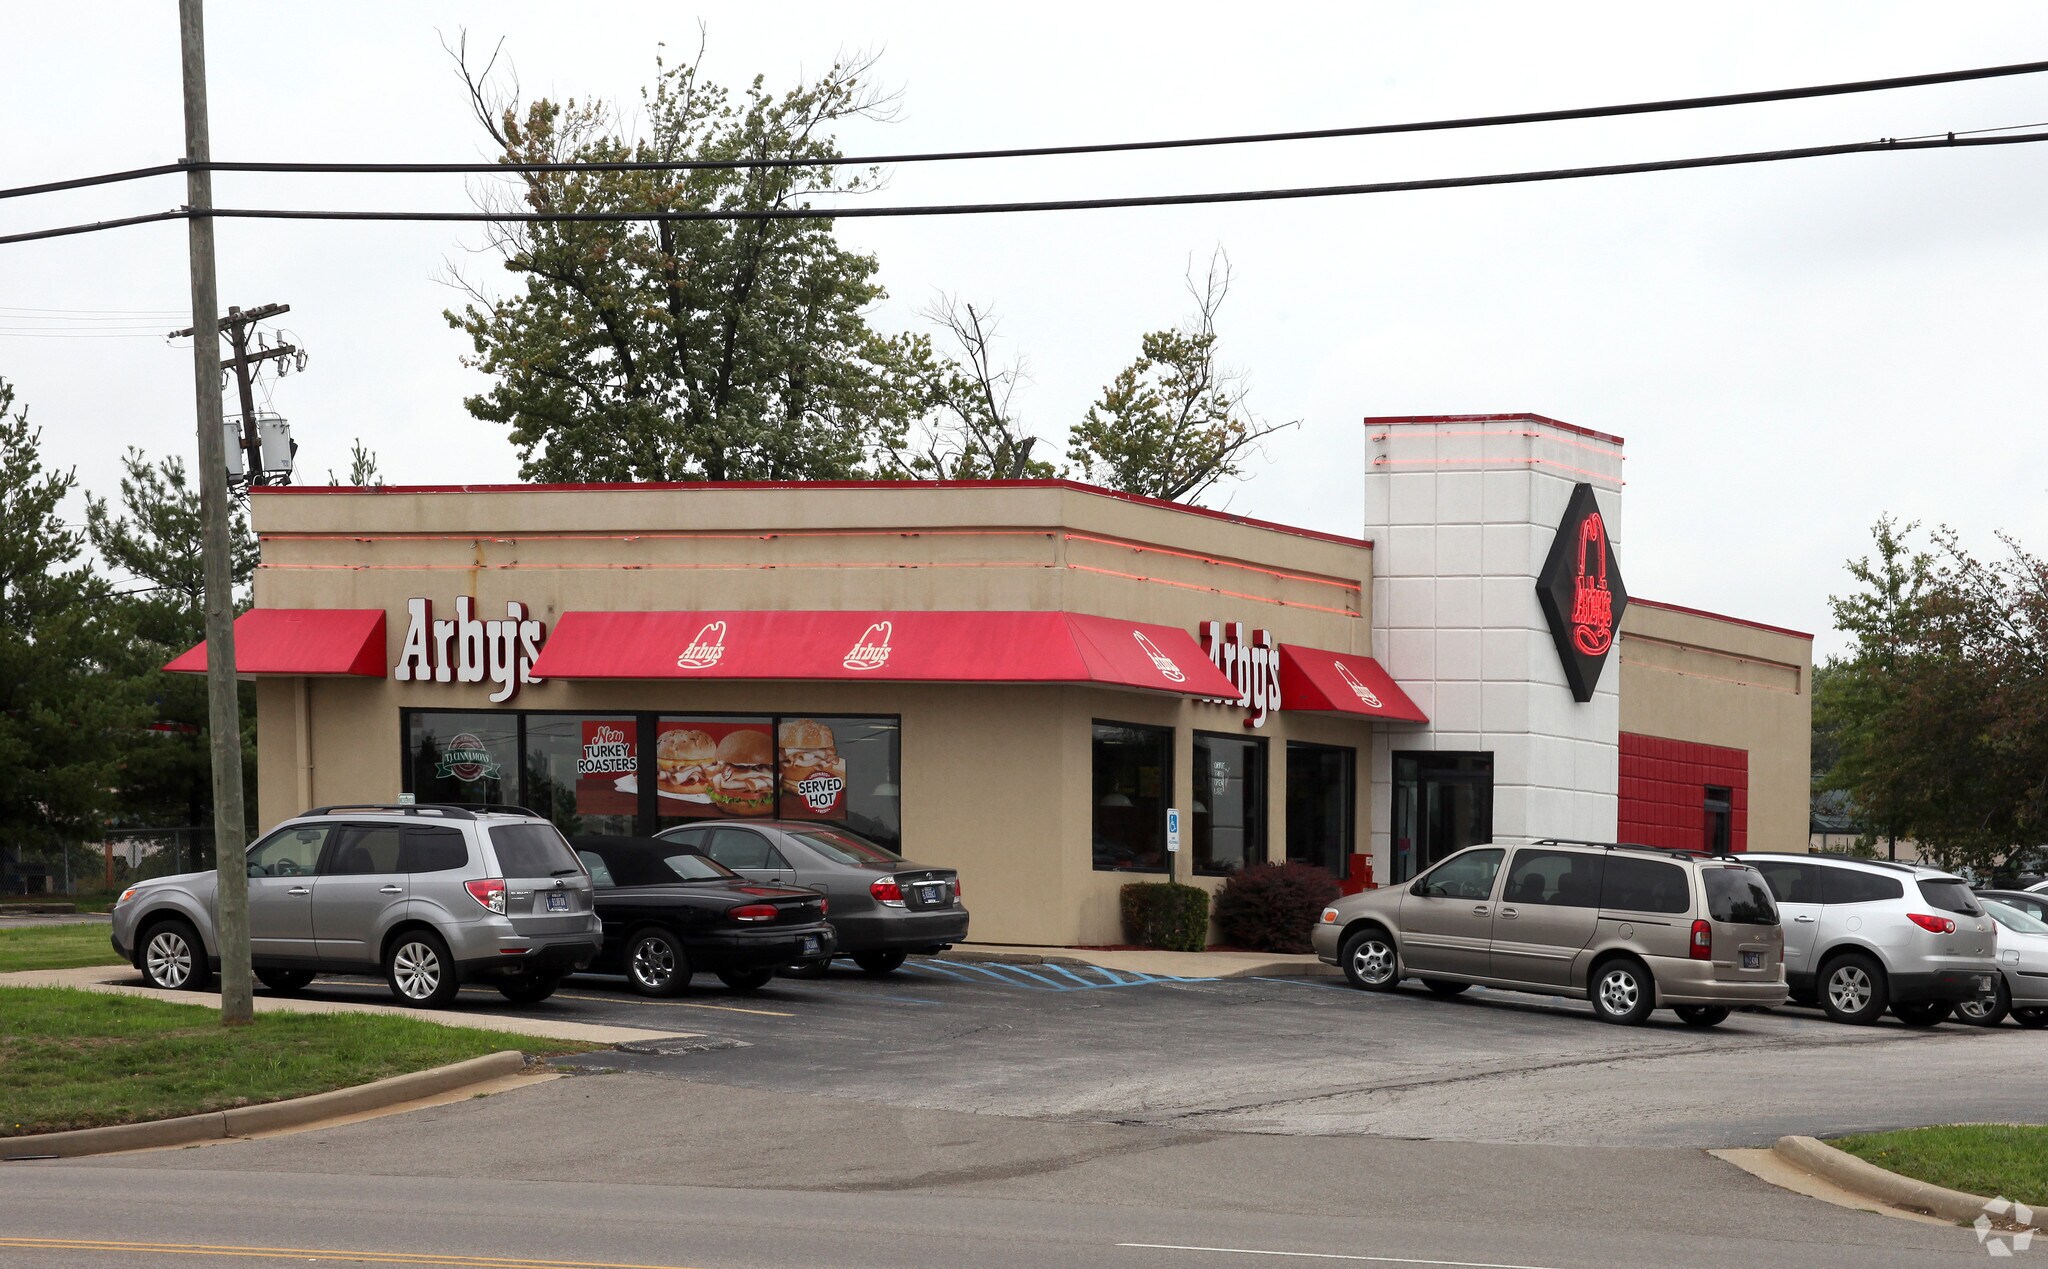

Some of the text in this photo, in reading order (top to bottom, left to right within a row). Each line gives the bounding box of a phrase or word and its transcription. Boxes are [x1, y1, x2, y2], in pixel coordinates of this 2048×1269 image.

[395, 595, 546, 703] Arby's
[678, 642, 726, 663] Arby's
[843, 643, 892, 664] Arby's
[592, 726, 624, 745] New
[584, 744, 629, 758] TURKEY
[578, 758, 637, 772] ROASTERS
[798, 778, 842, 794] SERVED
[809, 792, 834, 806] HOT
